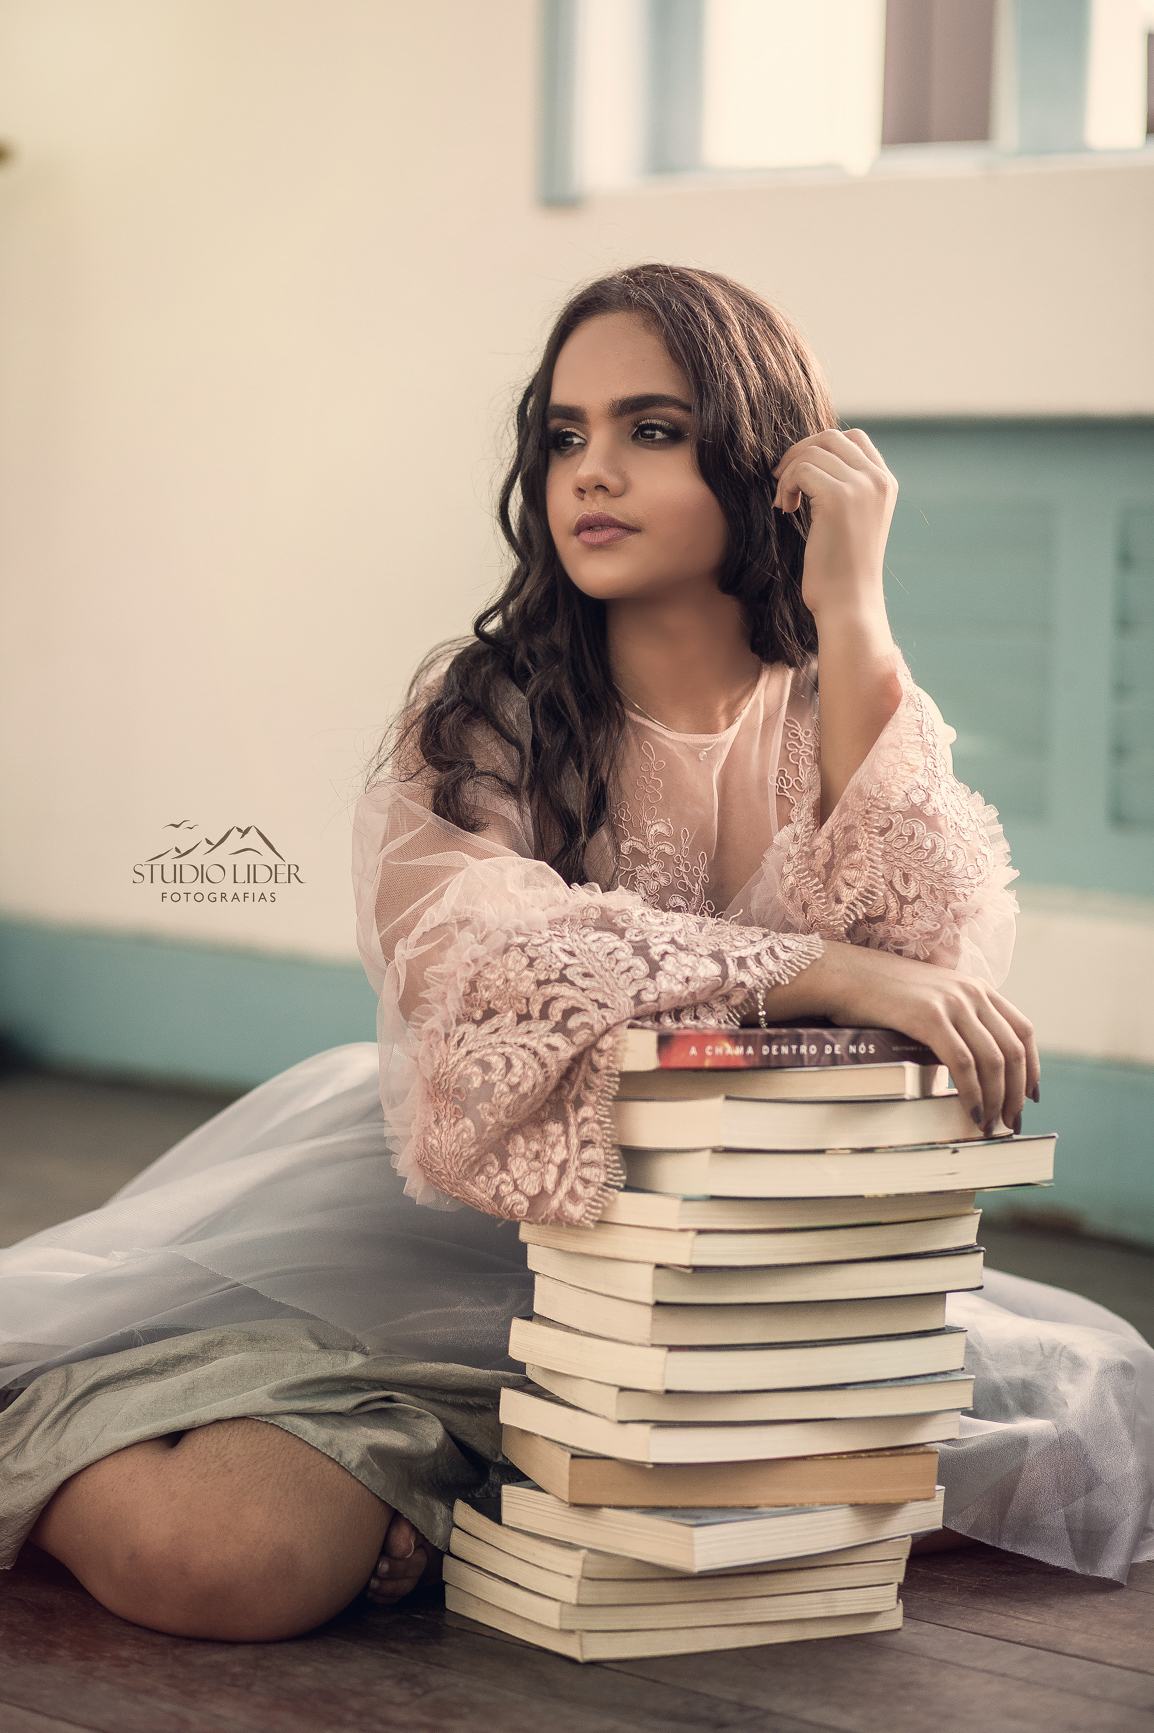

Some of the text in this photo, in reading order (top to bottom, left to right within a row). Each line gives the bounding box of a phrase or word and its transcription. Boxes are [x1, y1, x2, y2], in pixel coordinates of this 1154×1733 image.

[689, 1043, 876, 1056] A CHAMA DENTRO DE NÓS
